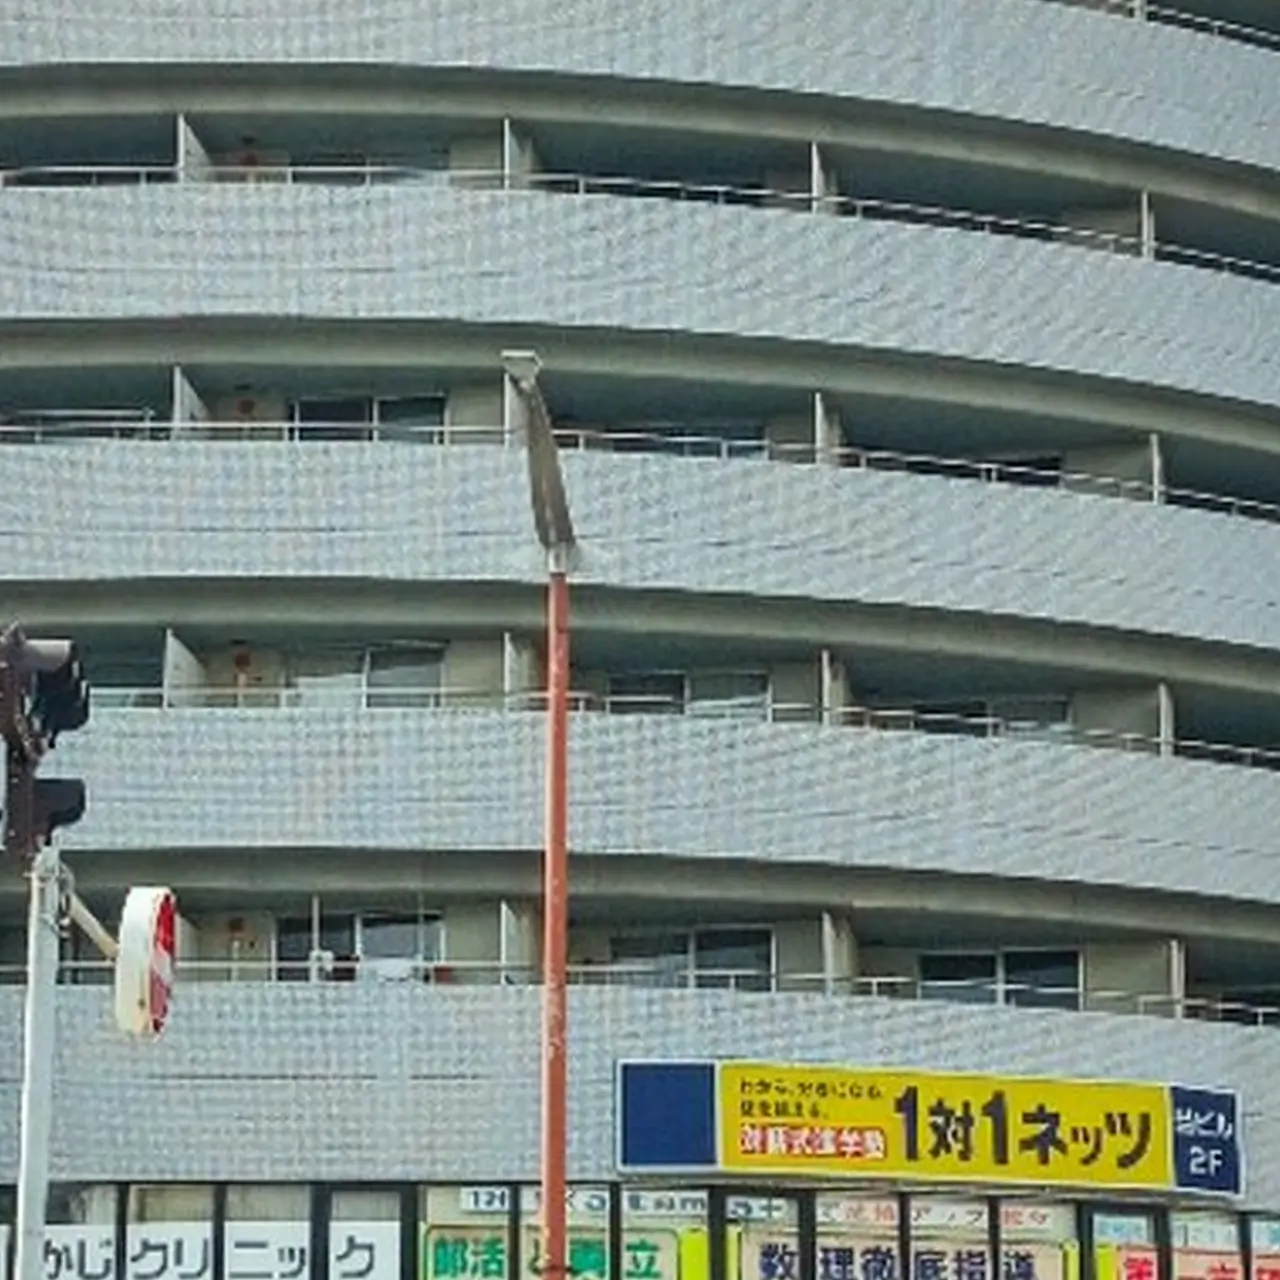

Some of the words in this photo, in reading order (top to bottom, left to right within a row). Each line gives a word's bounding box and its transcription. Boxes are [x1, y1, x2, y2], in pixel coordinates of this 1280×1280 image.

[894, 1085, 1152, 1169] 1対1ネッツ
[1189, 1146, 1223, 1176] 2F
